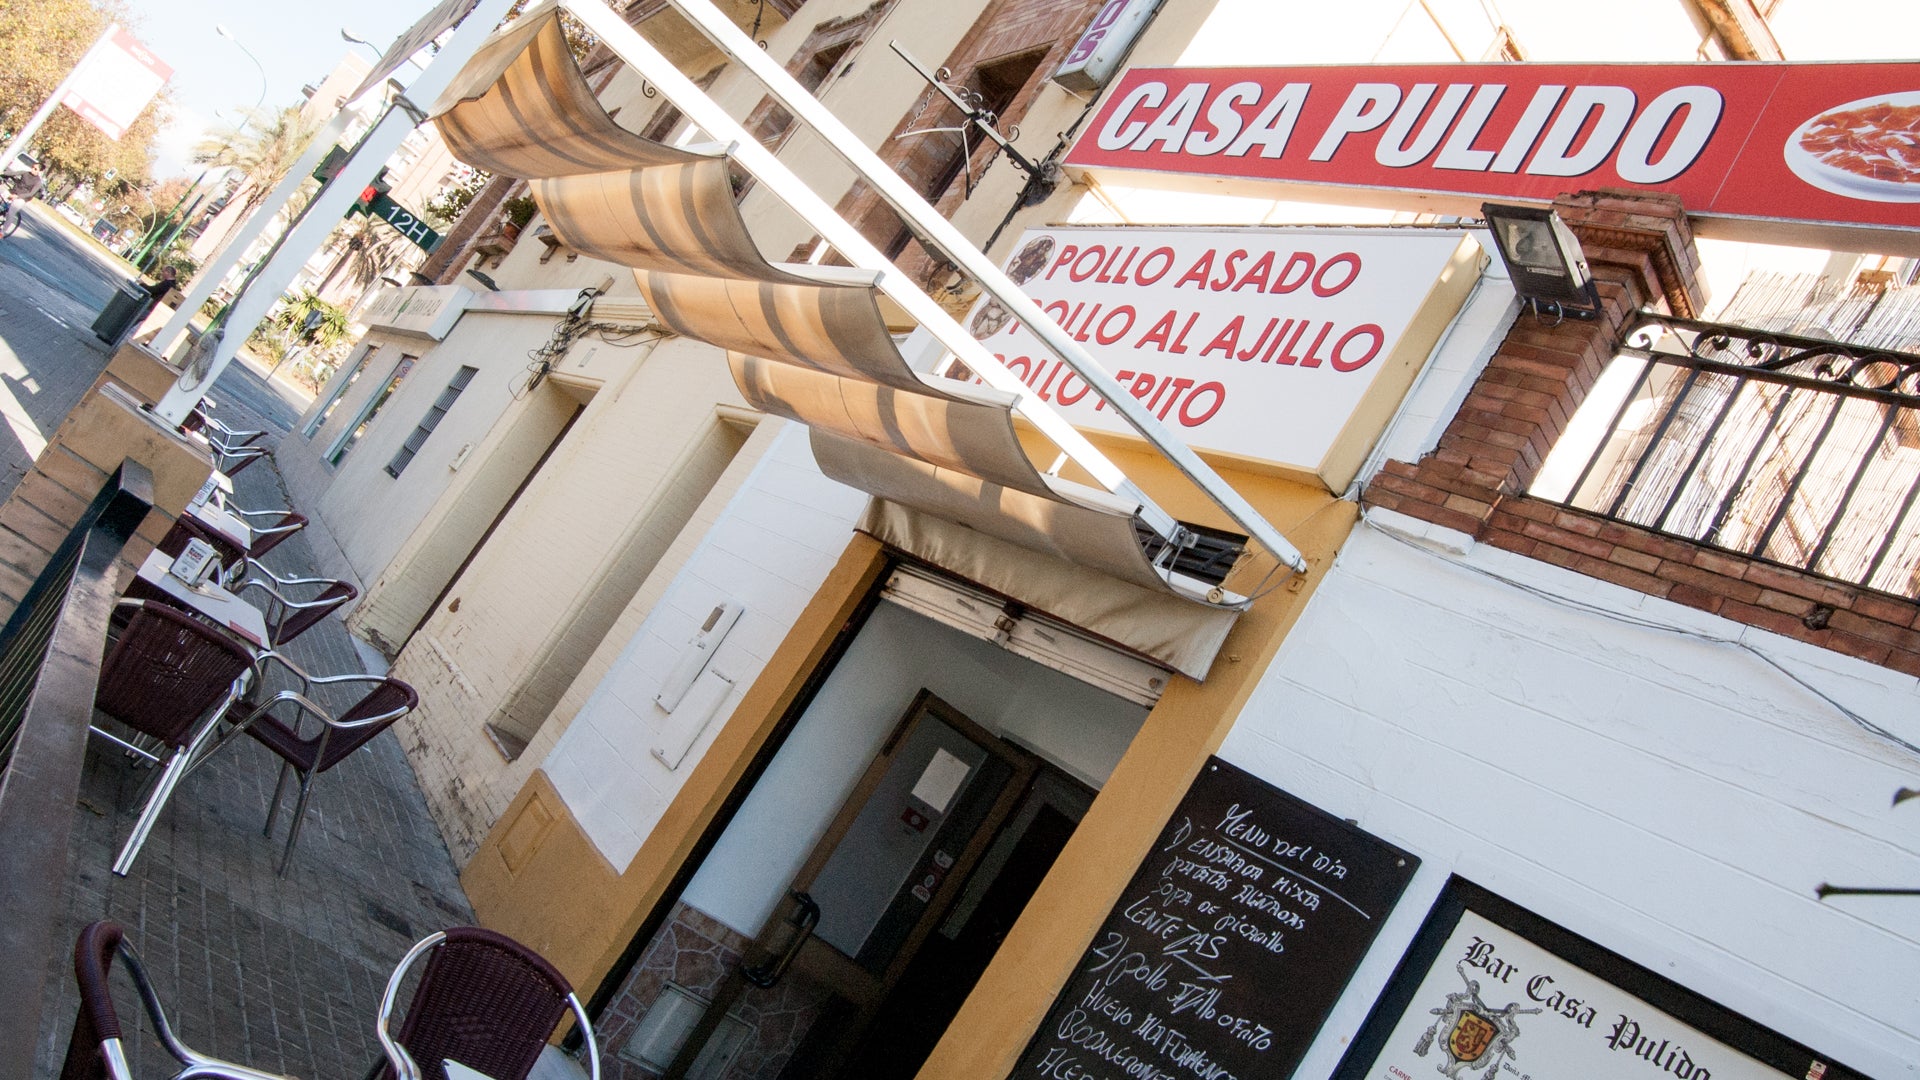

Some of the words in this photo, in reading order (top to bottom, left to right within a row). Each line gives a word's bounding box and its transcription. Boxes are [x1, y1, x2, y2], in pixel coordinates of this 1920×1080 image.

[1097, 81, 1311, 159] CASA
[1308, 83, 1725, 184] PULIDO
[386, 205, 430, 244] 12H
[1045, 244, 1175, 287] POLLO
[1174, 248, 1362, 297] ASADO
[1134, 310, 1200, 355] AL
[1199, 315, 1384, 373] AJILLO
[975, 353, 1092, 407] OLLO
[1215, 803, 1270, 847] MENU
[1081, 979, 1132, 1026] HUEVO
[1459, 936, 1519, 984] Bar
[1526, 973, 1598, 1029] Casa
[1604, 1013, 1711, 1080] Pulido
